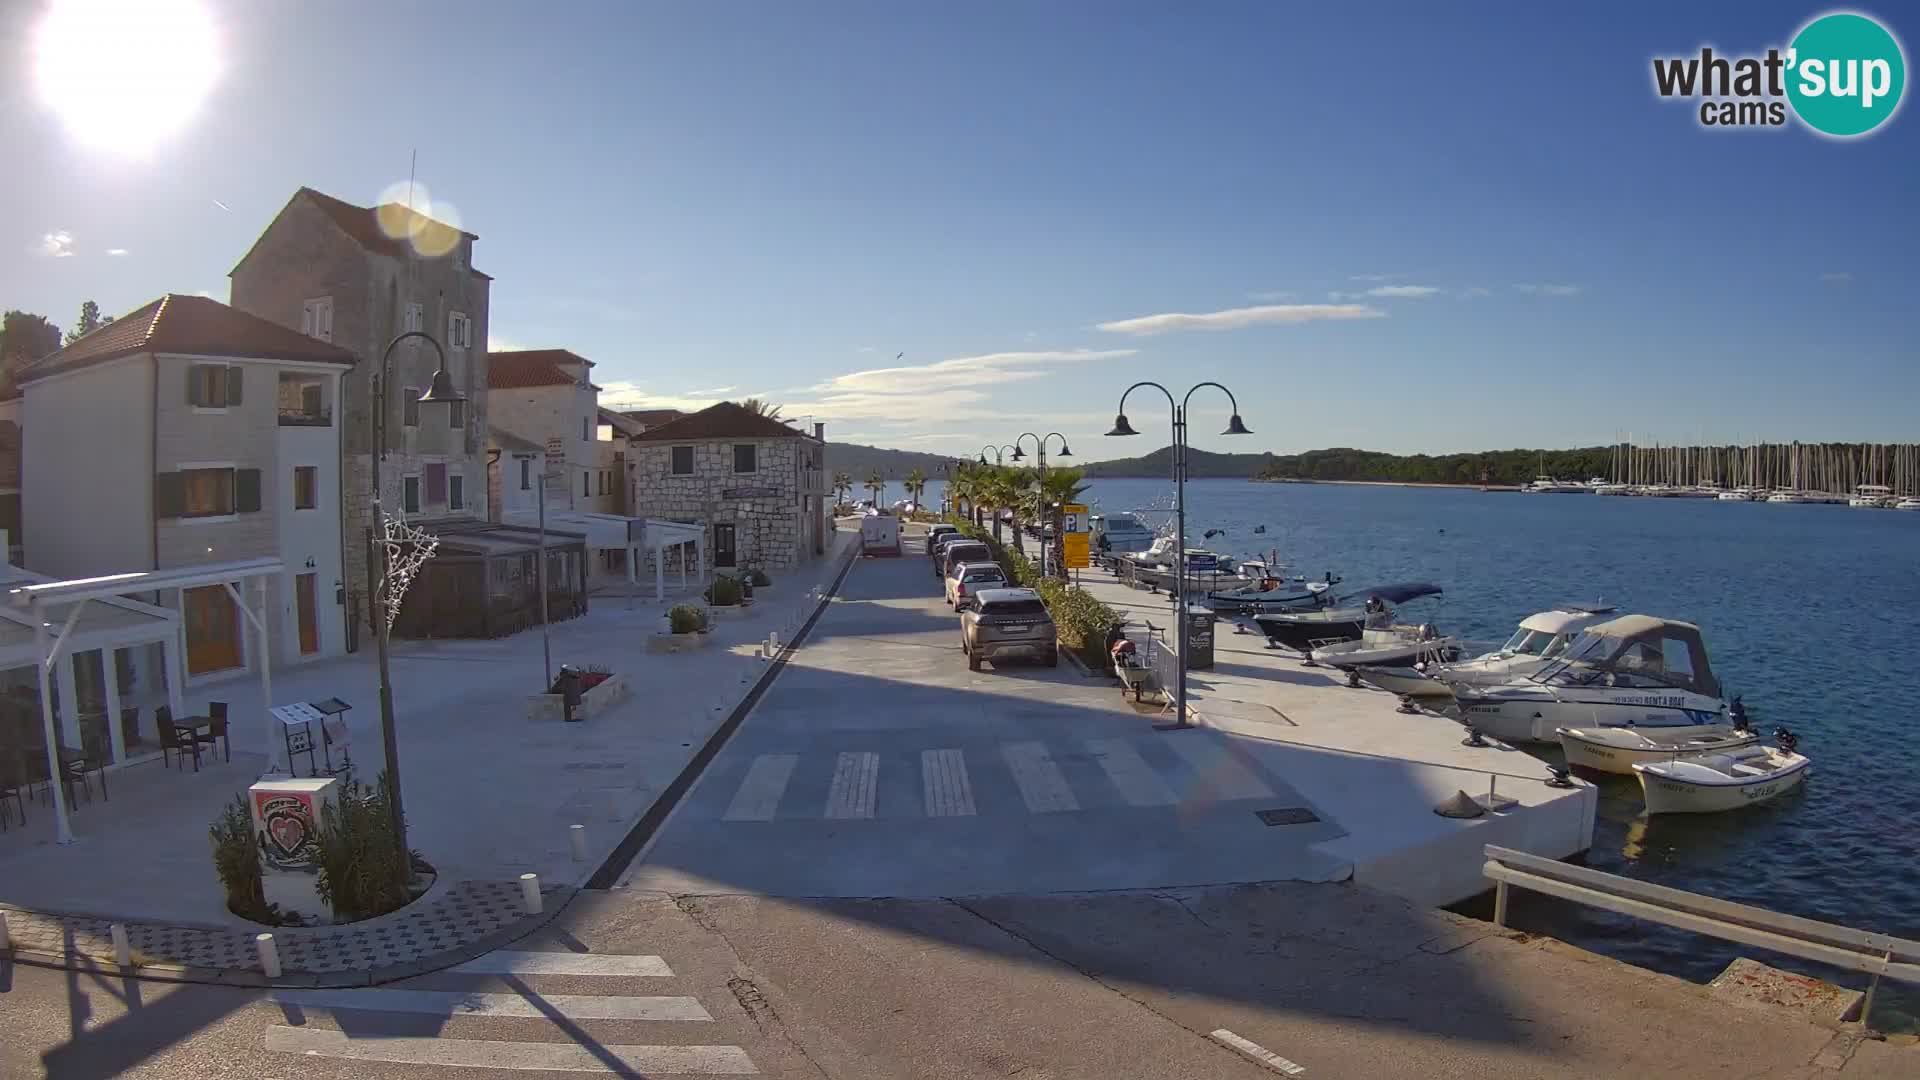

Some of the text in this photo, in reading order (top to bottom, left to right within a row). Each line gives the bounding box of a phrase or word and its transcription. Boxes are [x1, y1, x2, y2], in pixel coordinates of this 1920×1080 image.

[1065, 514, 1076, 531] P
[1645, 696, 1662, 705] RENT
[1669, 696, 1686, 707] BOAT
